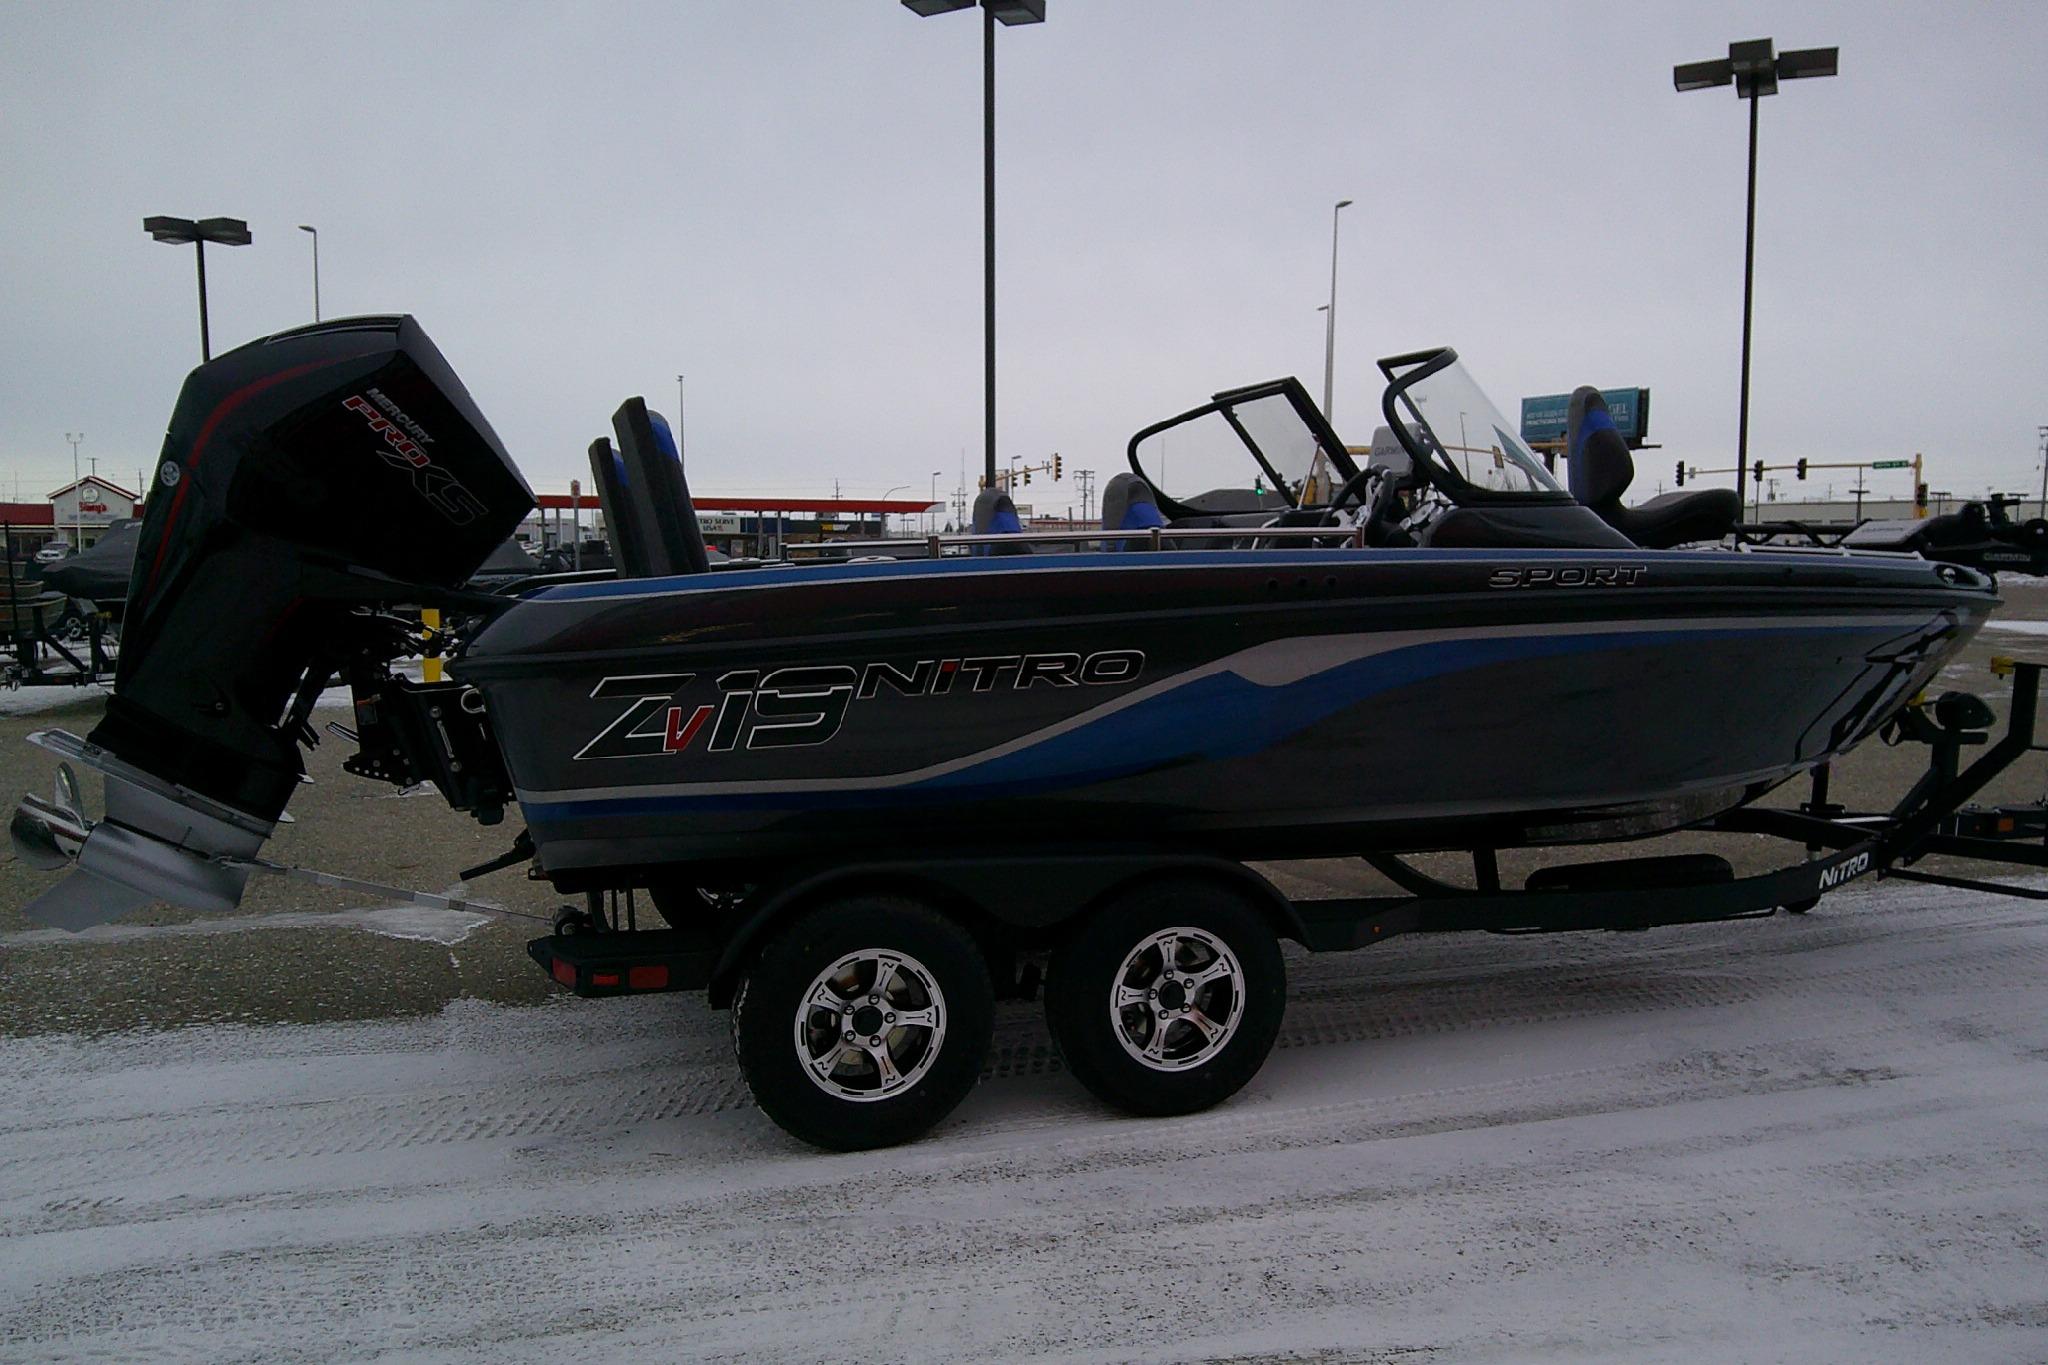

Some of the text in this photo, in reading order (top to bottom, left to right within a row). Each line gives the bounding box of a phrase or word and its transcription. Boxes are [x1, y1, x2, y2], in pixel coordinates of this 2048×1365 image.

[366, 387, 435, 444] MERCURY
[342, 395, 489, 526] PRO XS
[1488, 565, 1648, 588] SPORT
[856, 649, 1146, 699] NITRO
[1819, 852, 1869, 890] NITRO
